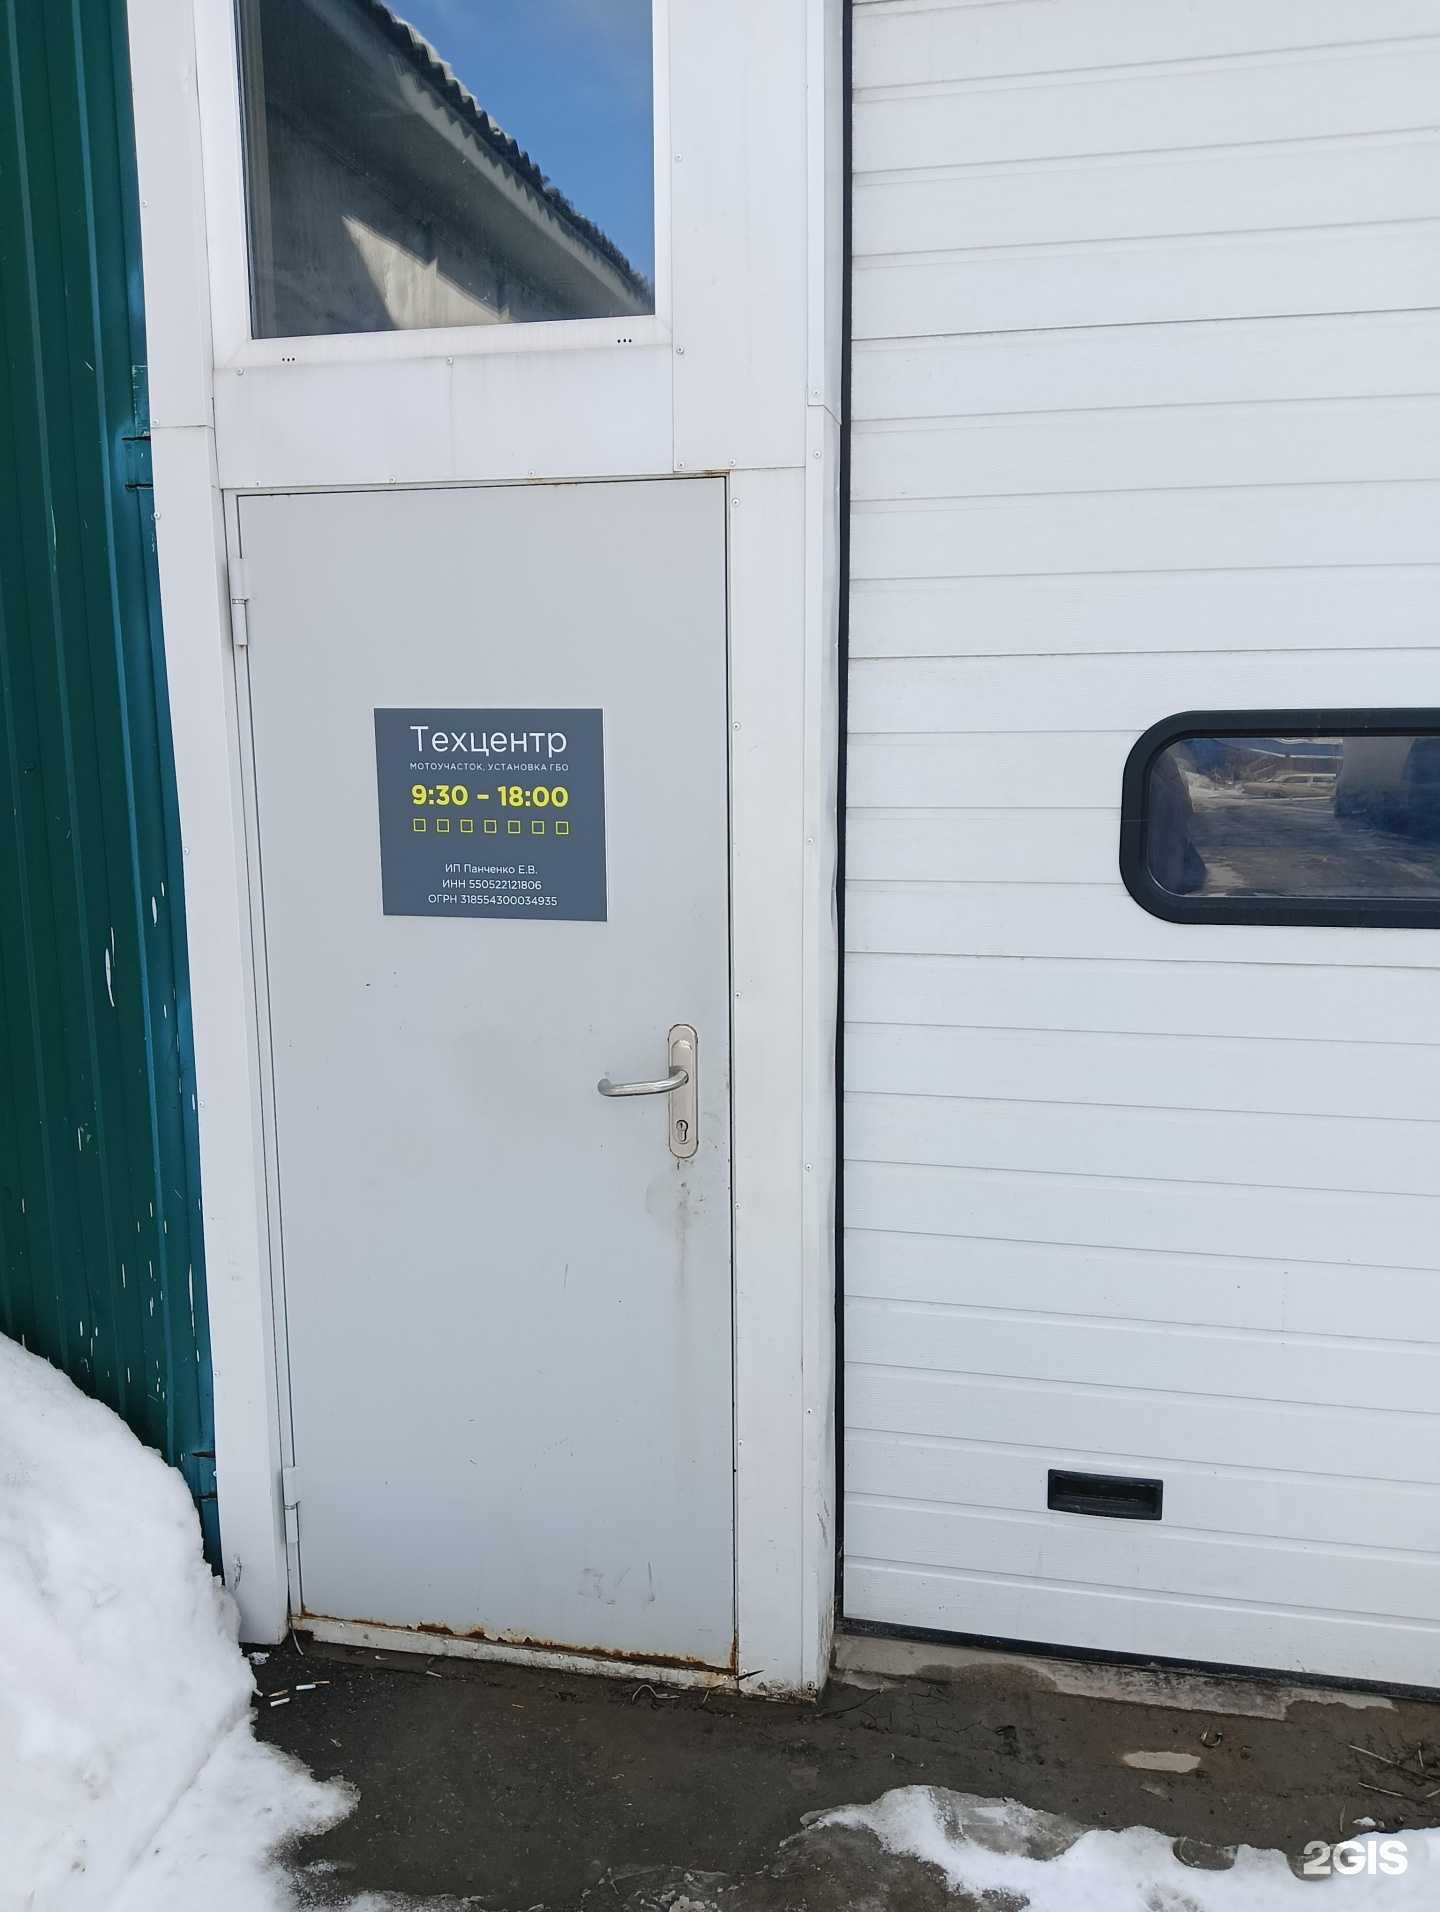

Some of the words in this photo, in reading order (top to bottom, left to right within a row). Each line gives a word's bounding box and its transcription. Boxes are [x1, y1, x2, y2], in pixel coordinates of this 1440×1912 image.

[410, 725, 567, 758] Техцентр
[409, 762, 486, 772] МОТОУЧАСТОК,
[487, 763, 547, 772] УСТАНОВКА
[549, 764, 569, 772] ГБО
[411, 784, 469, 806] 9:30
[497, 785, 569, 807] 18:00
[445, 863, 461, 873] ИП
[463, 863, 516, 874] Панченко
[518, 865, 538, 875] Е.В.
[442, 879, 466, 889] ИНН
[469, 880, 542, 890] 550522121806
[427, 894, 458, 904] ОГРН
[460, 895, 558, 906] 318554300034935
